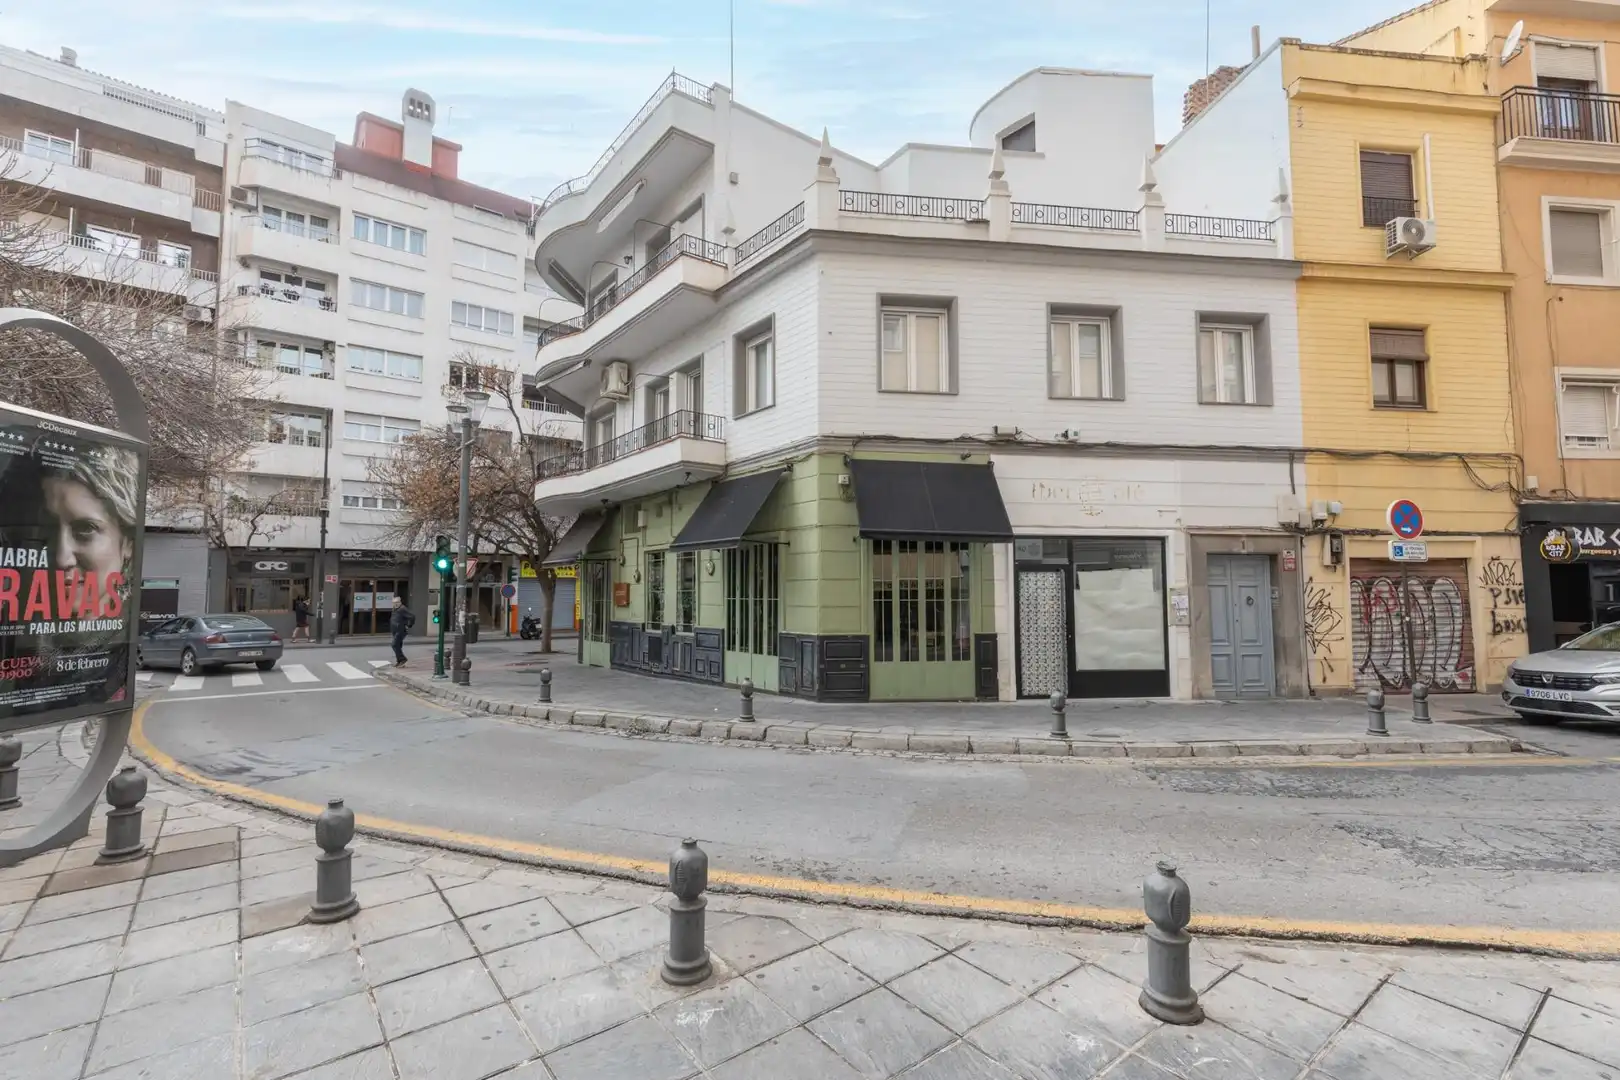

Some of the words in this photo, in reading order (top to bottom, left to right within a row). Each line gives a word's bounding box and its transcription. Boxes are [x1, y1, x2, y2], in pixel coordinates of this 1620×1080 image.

[37, 421, 77, 436] JCDecaux
[29, 622, 56, 635] PARA
[58, 620, 76, 633] LOS
[78, 619, 123, 632] MALVADOS
[56, 660, 63, 672] 8
[65, 660, 76, 671] de
[77, 657, 109, 670] febrero
[1530, 690, 1551, 699] 9706
[1552, 691, 1570, 700] LVC
